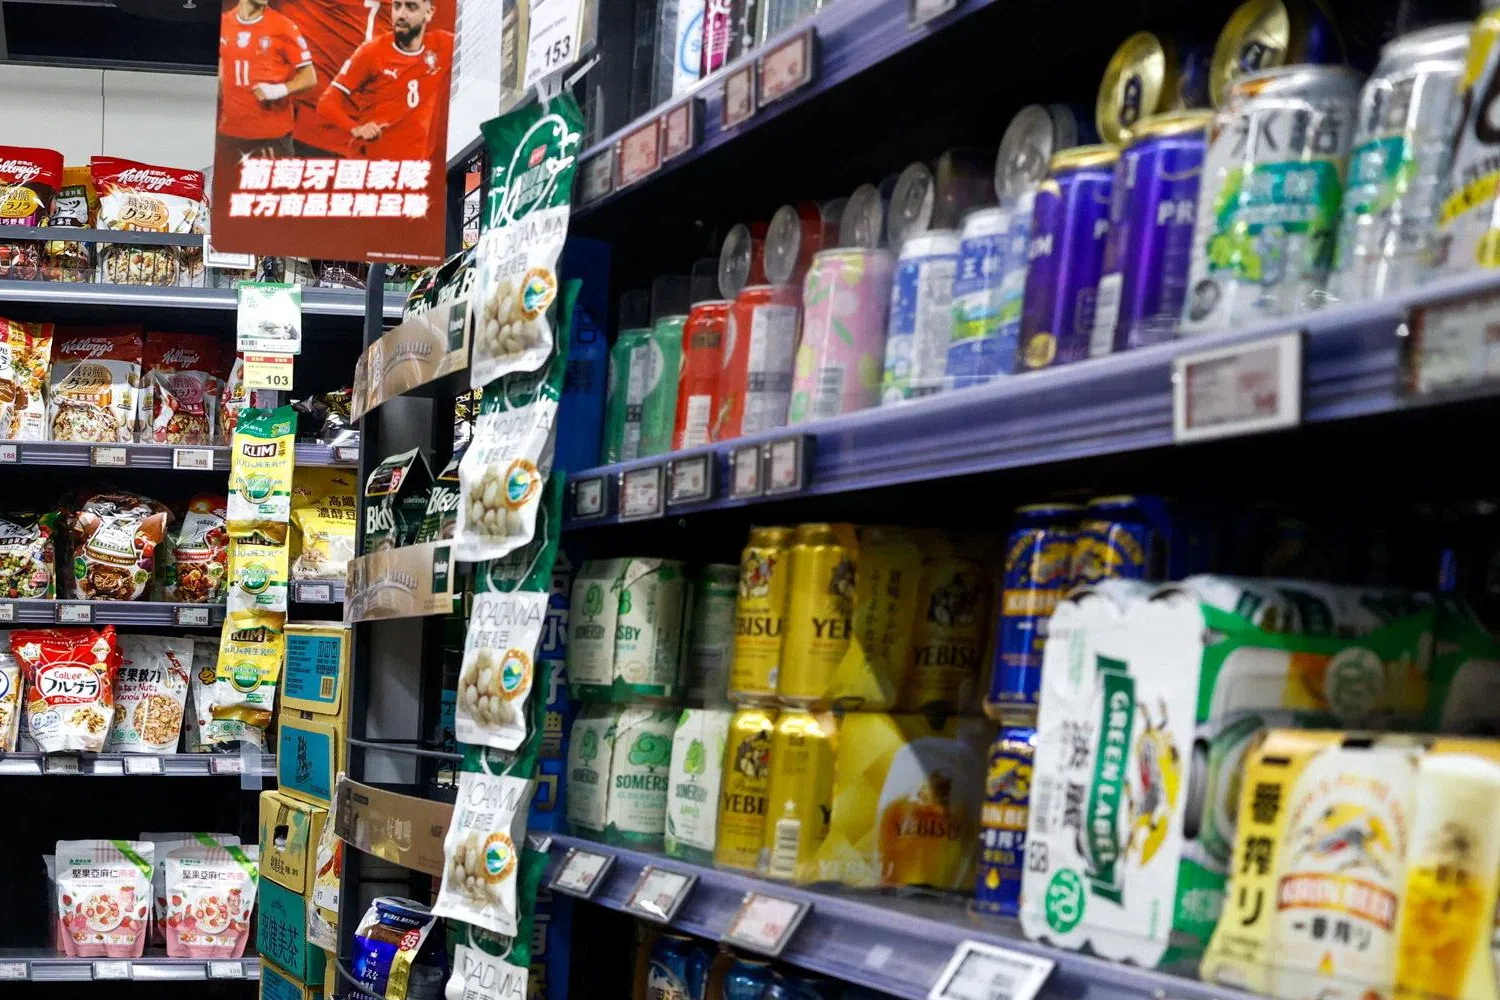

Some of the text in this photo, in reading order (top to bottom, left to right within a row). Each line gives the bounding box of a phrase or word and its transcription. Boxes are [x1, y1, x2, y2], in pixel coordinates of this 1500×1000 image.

[545, 36, 570, 66] 153
[234, 60, 249, 86] 11
[407, 80, 419, 107] 8
[118, 168, 174, 190] Kellogg's
[237, 158, 432, 192] 葡萄牙國家隊
[229, 192, 430, 219] 官方商品登陸全聯
[61, 337, 115, 357] Kellogg's
[266, 375, 289, 386] 103
[243, 444, 276, 457] KLIM
[194, 458, 207, 466] 188
[76, 612, 89, 620] 188
[231, 629, 265, 642] KLIM
[53, 670, 82, 680] Calbee
[44, 676, 98, 695] フルグラ
[1090, 689, 1132, 866] GREEN LABEL
[1237, 753, 1292, 927] 一番搾り
[400, 934, 419, 949] 35
